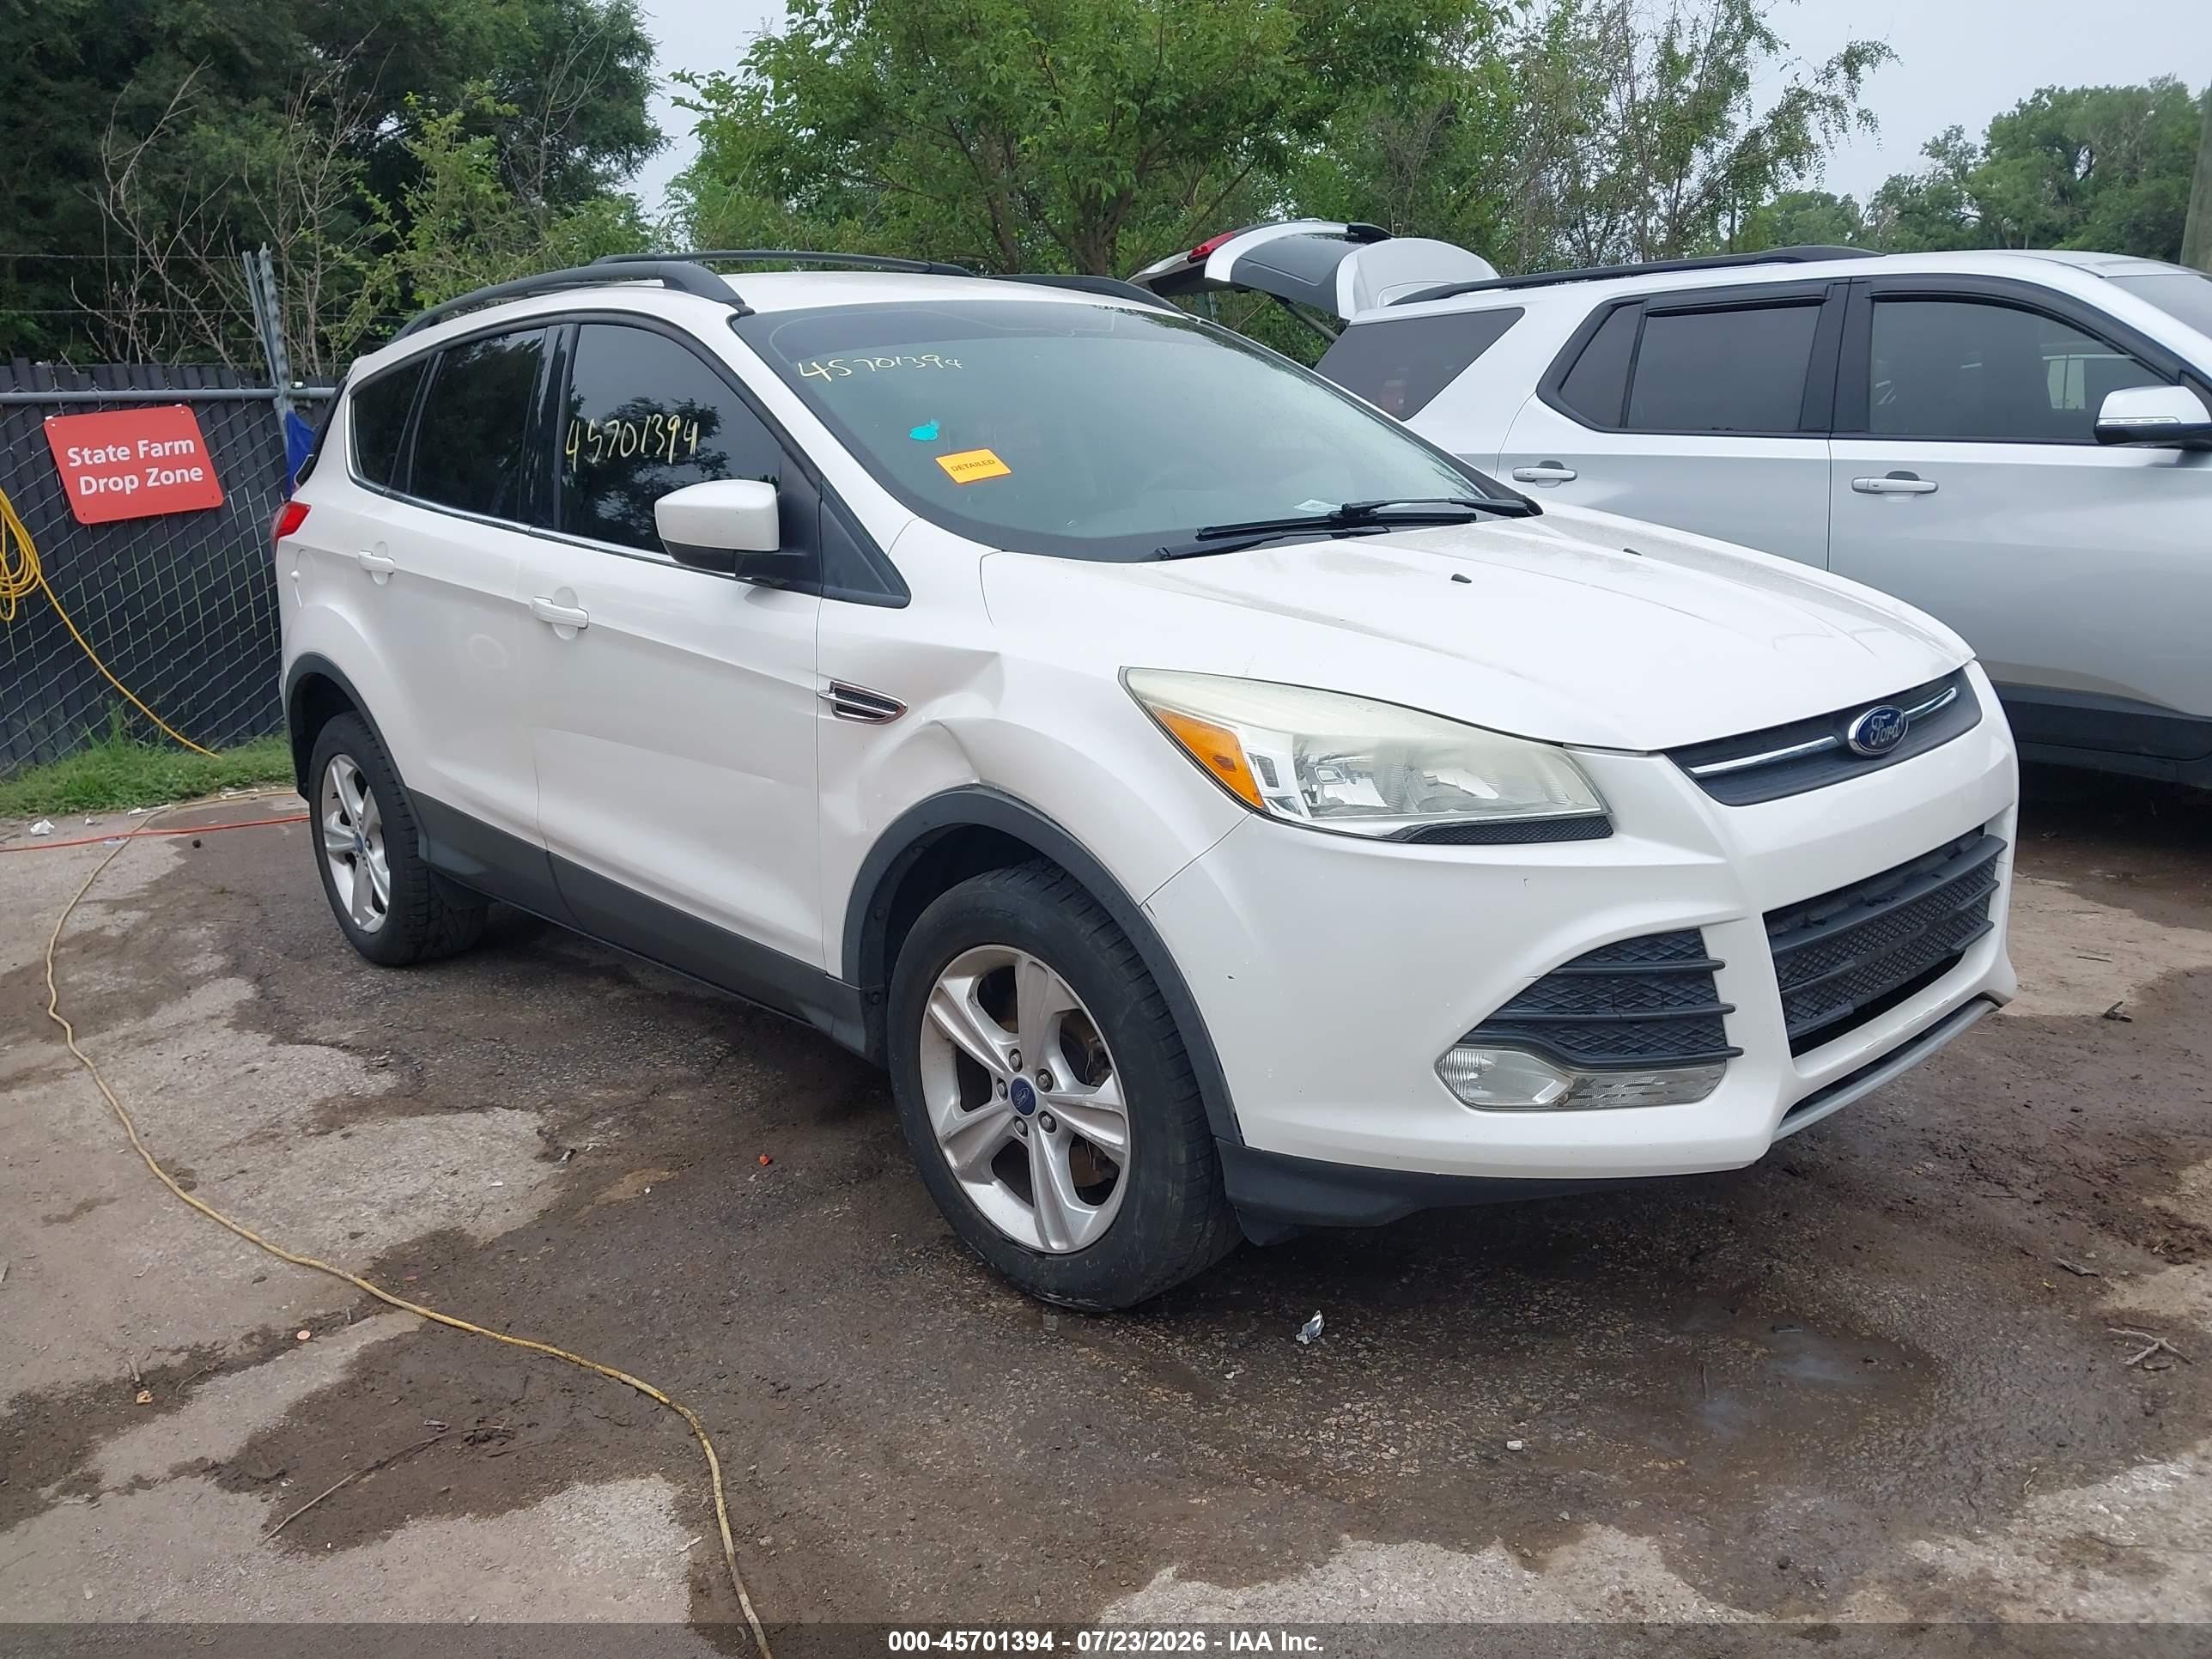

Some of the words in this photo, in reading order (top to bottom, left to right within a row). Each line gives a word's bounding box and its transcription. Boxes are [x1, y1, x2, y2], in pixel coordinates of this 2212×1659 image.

[798, 354, 963, 382] 45701394
[67, 444, 131, 468] State
[137, 439, 195, 459] Farm
[565, 413, 699, 472] 45701394
[79, 471, 139, 495] Drop
[146, 465, 204, 488] Zone
[950, 459, 996, 472] DETAILED
[1869, 713, 1905, 746] Ford
